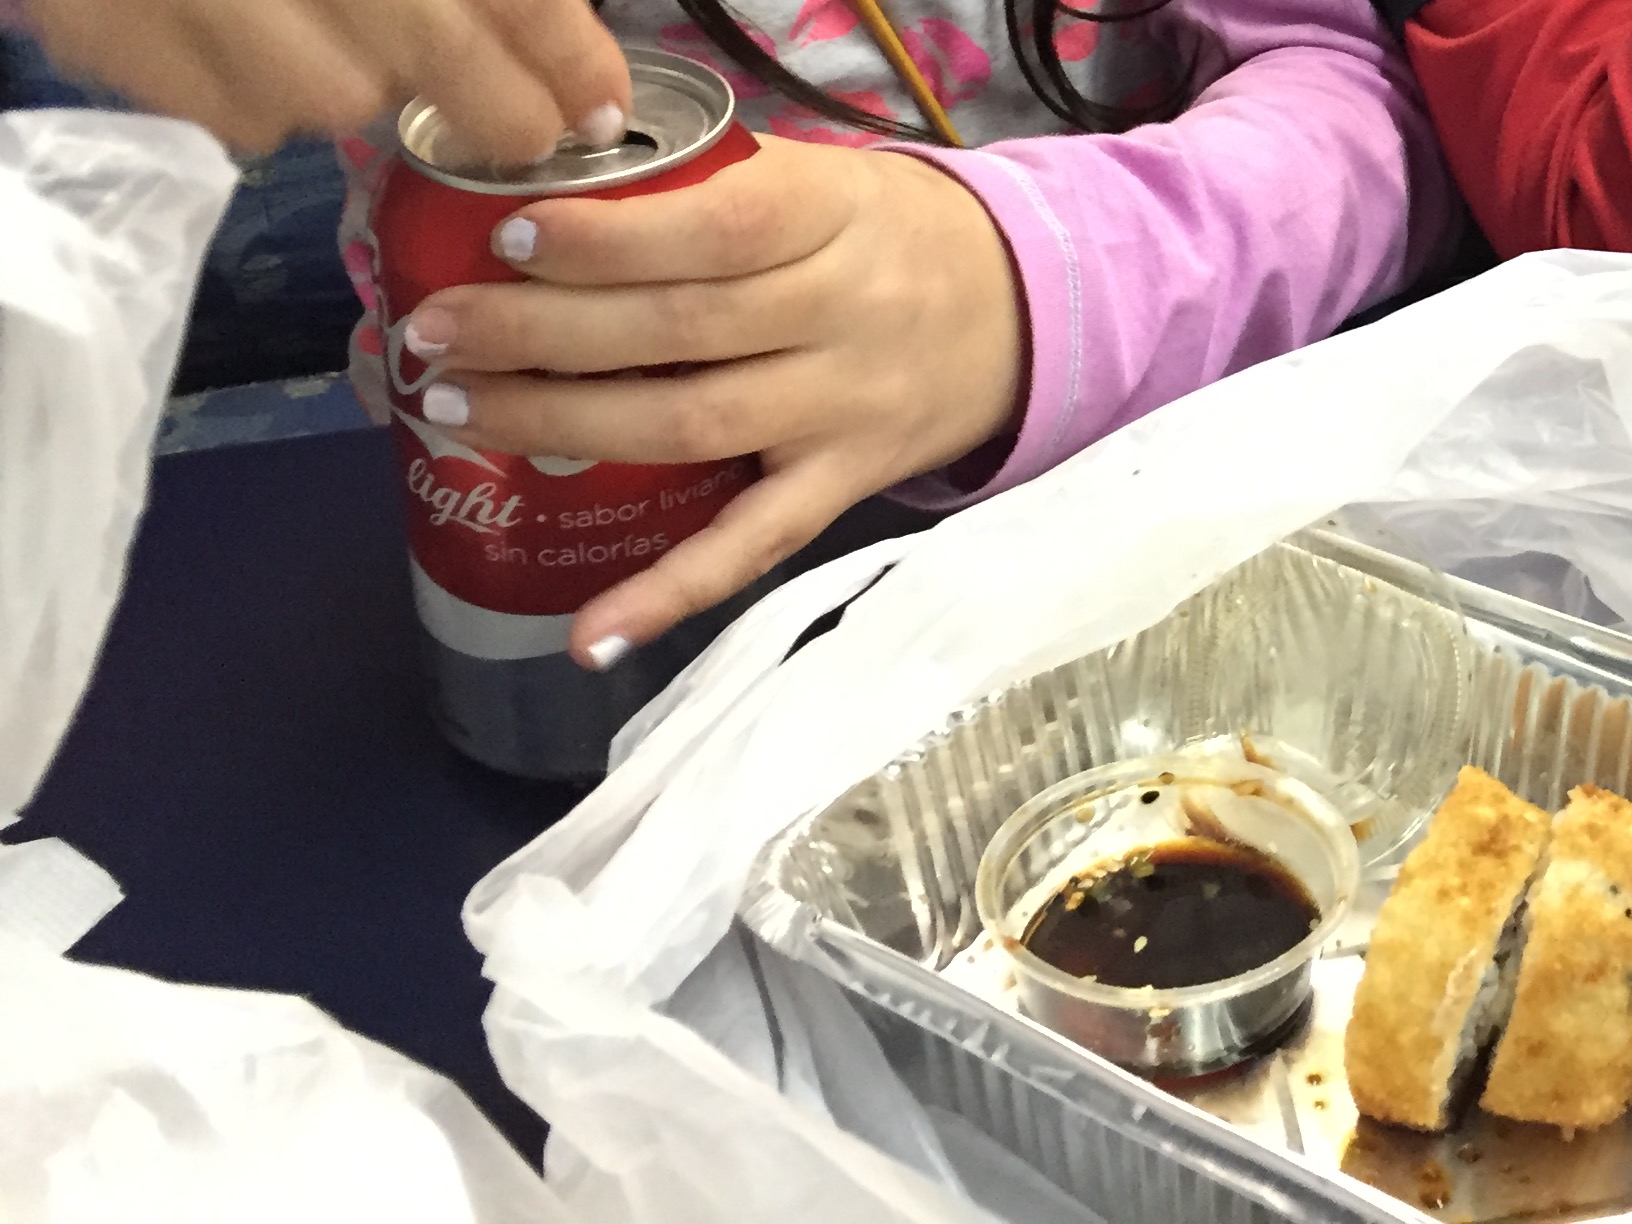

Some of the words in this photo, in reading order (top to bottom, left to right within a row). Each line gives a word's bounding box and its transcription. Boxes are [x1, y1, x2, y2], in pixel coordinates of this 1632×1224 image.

[407, 458, 525, 536] light
[558, 498, 651, 529] sabor
[659, 462, 746, 510] liviano
[484, 541, 528, 565] sin
[537, 531, 671, 567] calorías
